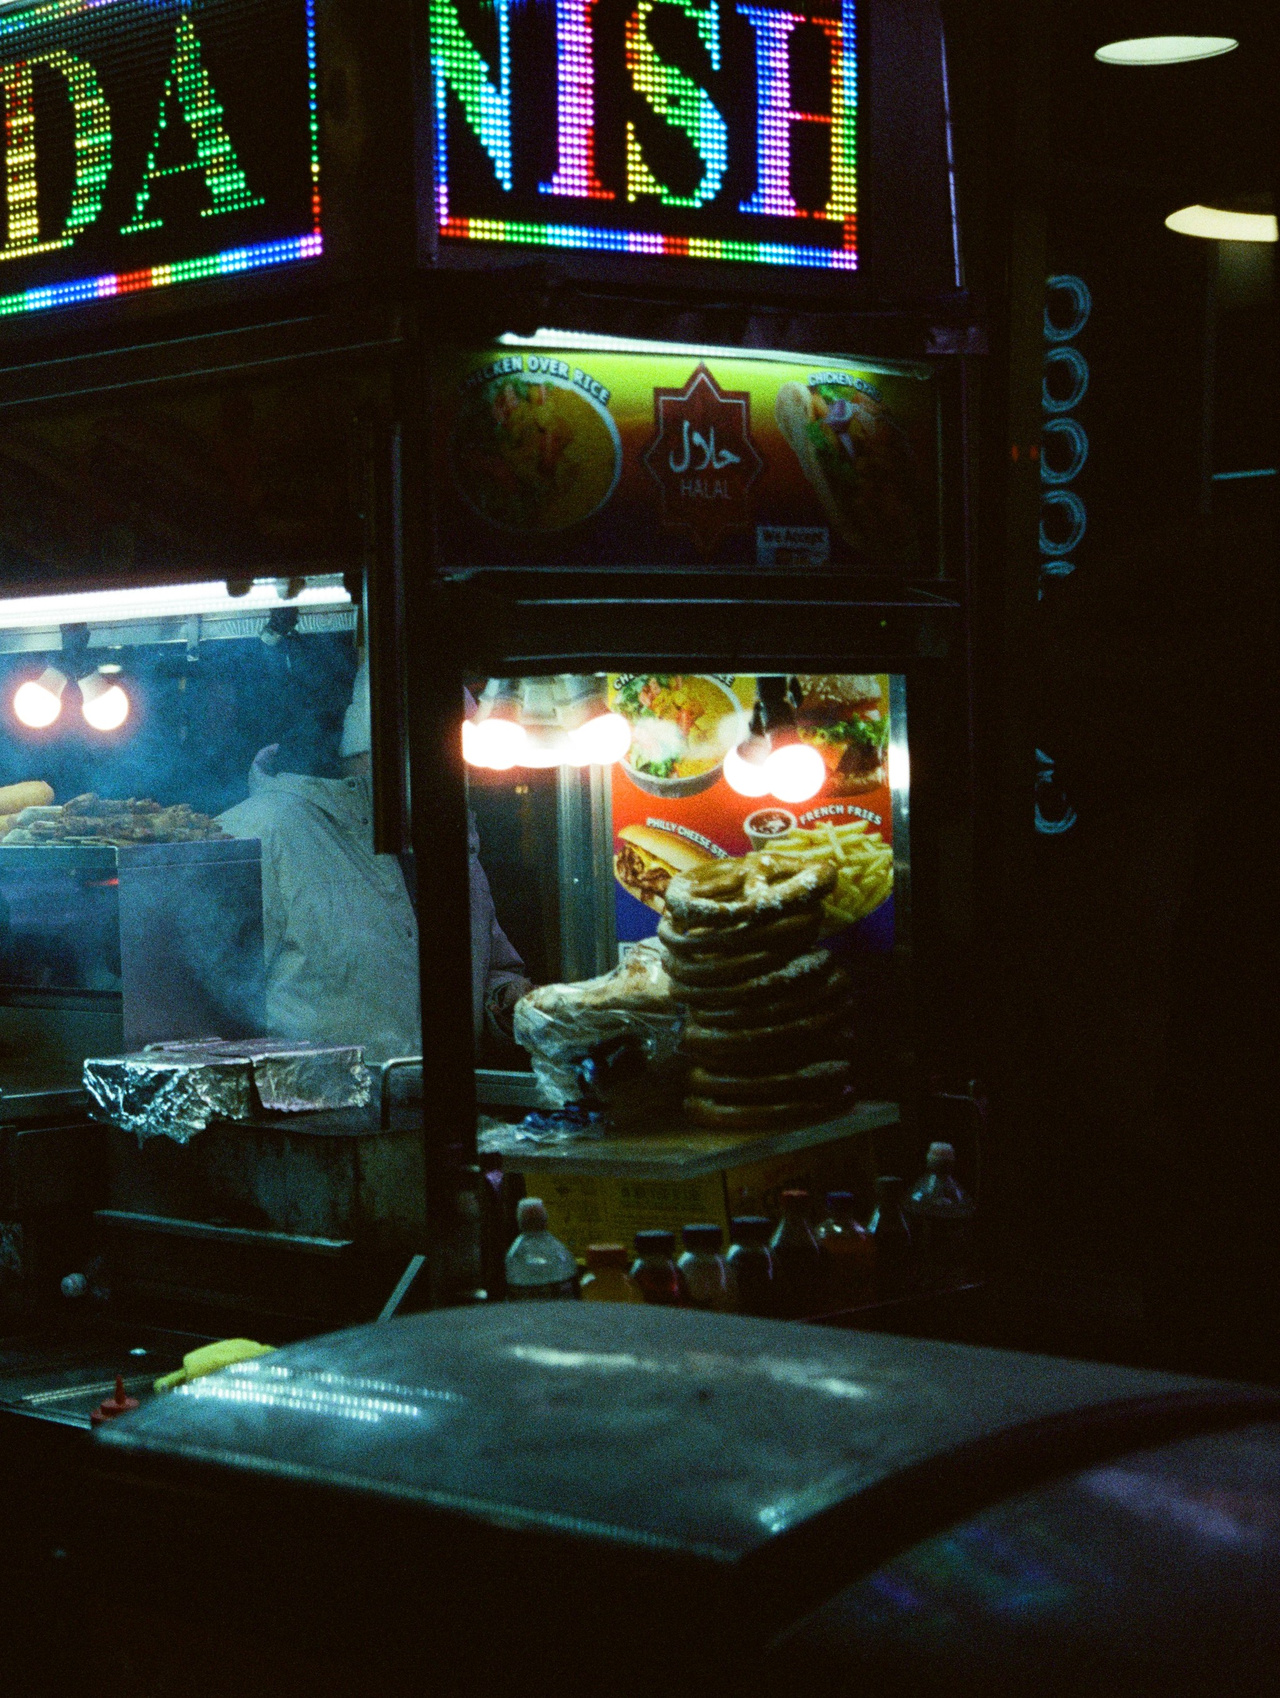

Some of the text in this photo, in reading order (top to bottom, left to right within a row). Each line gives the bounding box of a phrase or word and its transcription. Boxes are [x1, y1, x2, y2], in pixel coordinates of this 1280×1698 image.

[526, 352, 570, 381] OVER
[572, 367, 612, 406] RICE
[668, 420, 742, 474] حلال
[680, 480, 730, 500] HALAL
[799, 804, 883, 827] FRENCH FRIES
[645, 816, 677, 834] PHILLY
[677, 825, 712, 851] CHEESE
